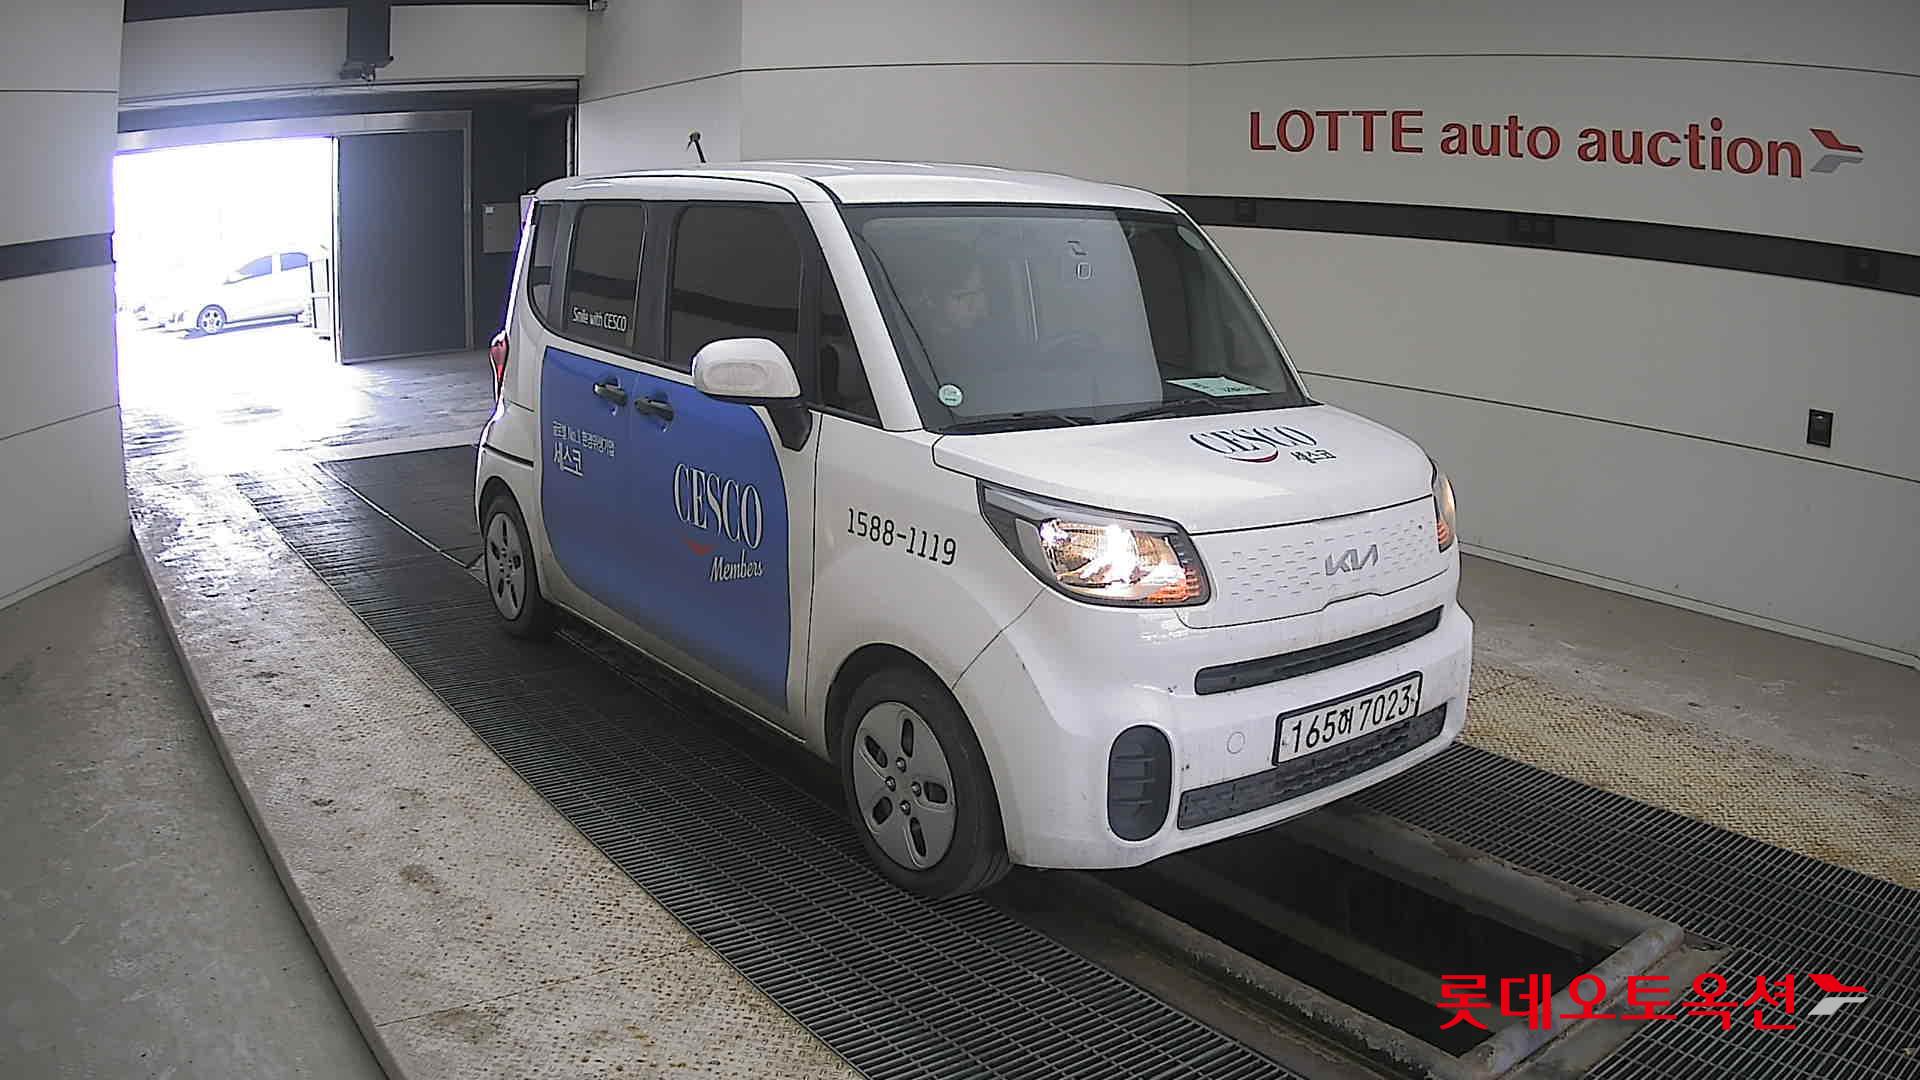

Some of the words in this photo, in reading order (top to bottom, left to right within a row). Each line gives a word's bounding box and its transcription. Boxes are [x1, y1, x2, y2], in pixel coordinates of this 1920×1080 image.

[1250, 110, 1424, 153] LOTTE
[1440, 116, 1560, 160] auto
[1577, 117, 1802, 178] auction
[604, 313, 627, 332] CESCO
[553, 440, 583, 476] 세스코
[1189, 425, 1317, 458] CESCO
[674, 463, 763, 549] CESCO
[847, 507, 957, 566] 1588-1119
[709, 549, 763, 583] Members
[1292, 705, 1355, 753] 165허
[1359, 684, 1412, 731] 7023
